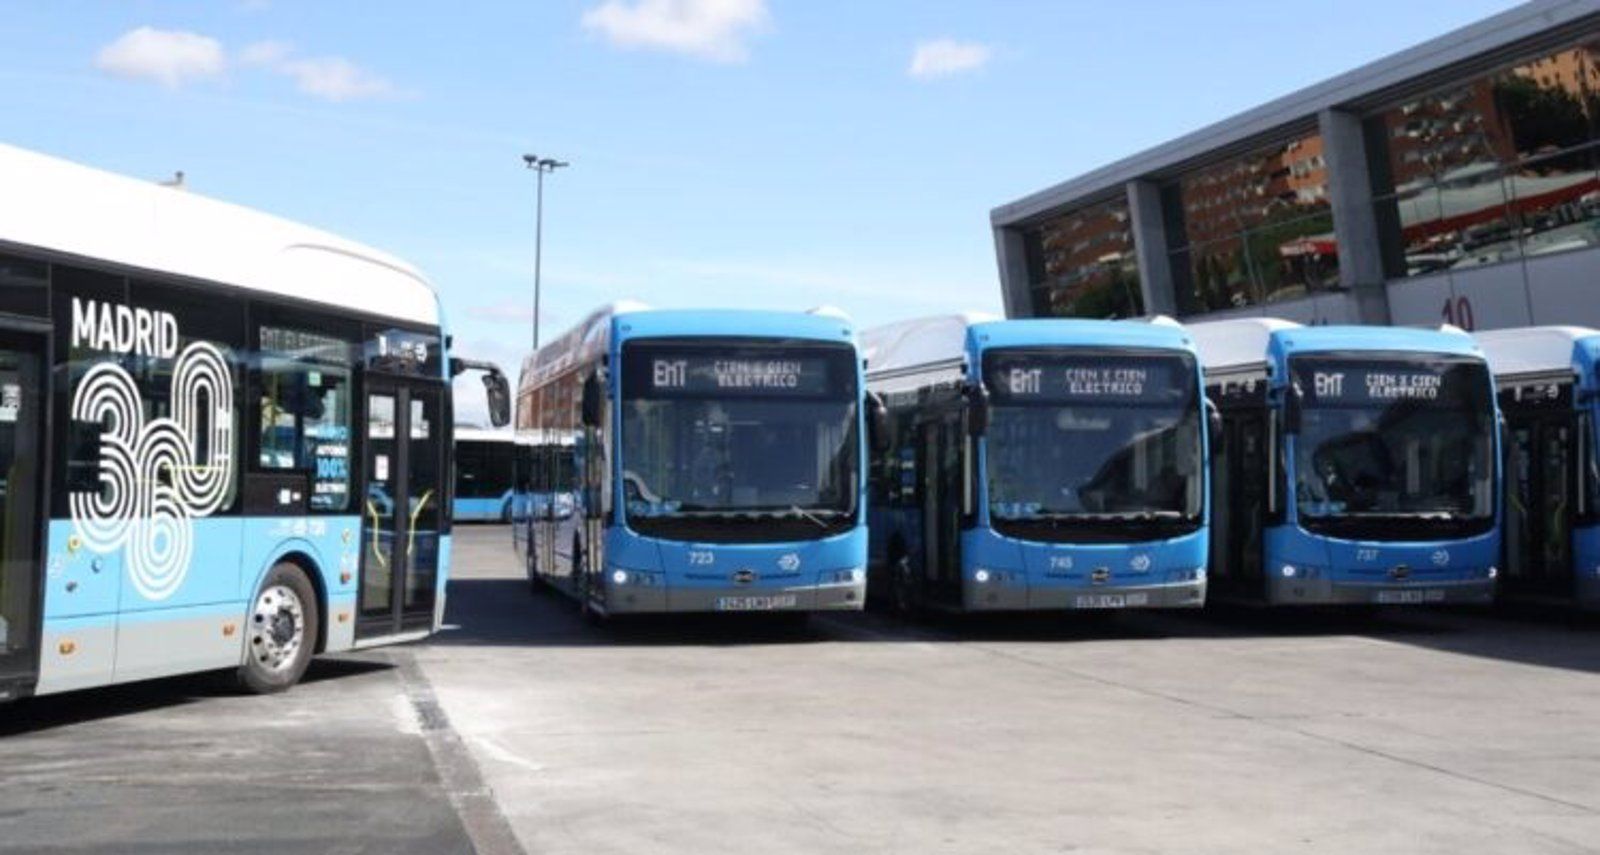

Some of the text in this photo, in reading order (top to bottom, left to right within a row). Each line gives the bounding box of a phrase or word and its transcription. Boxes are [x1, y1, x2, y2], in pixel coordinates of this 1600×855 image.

[1442, 297, 1474, 331] 10
[72, 297, 178, 359] MADRID
[653, 360, 688, 387] EMT
[718, 374, 798, 387] ELECTRICO
[1066, 369, 1098, 382] CIEN
[1115, 370, 1147, 382] CIEN
[1366, 374, 1396, 386] CIEN
[1411, 375, 1441, 387] CIEN
[1010, 369, 1042, 394] EMT
[1070, 381, 1143, 395] ELECTRICO
[1314, 372, 1345, 397] EMT
[1369, 385, 1438, 399] ELECTRICO
[689, 551, 715, 565] 723
